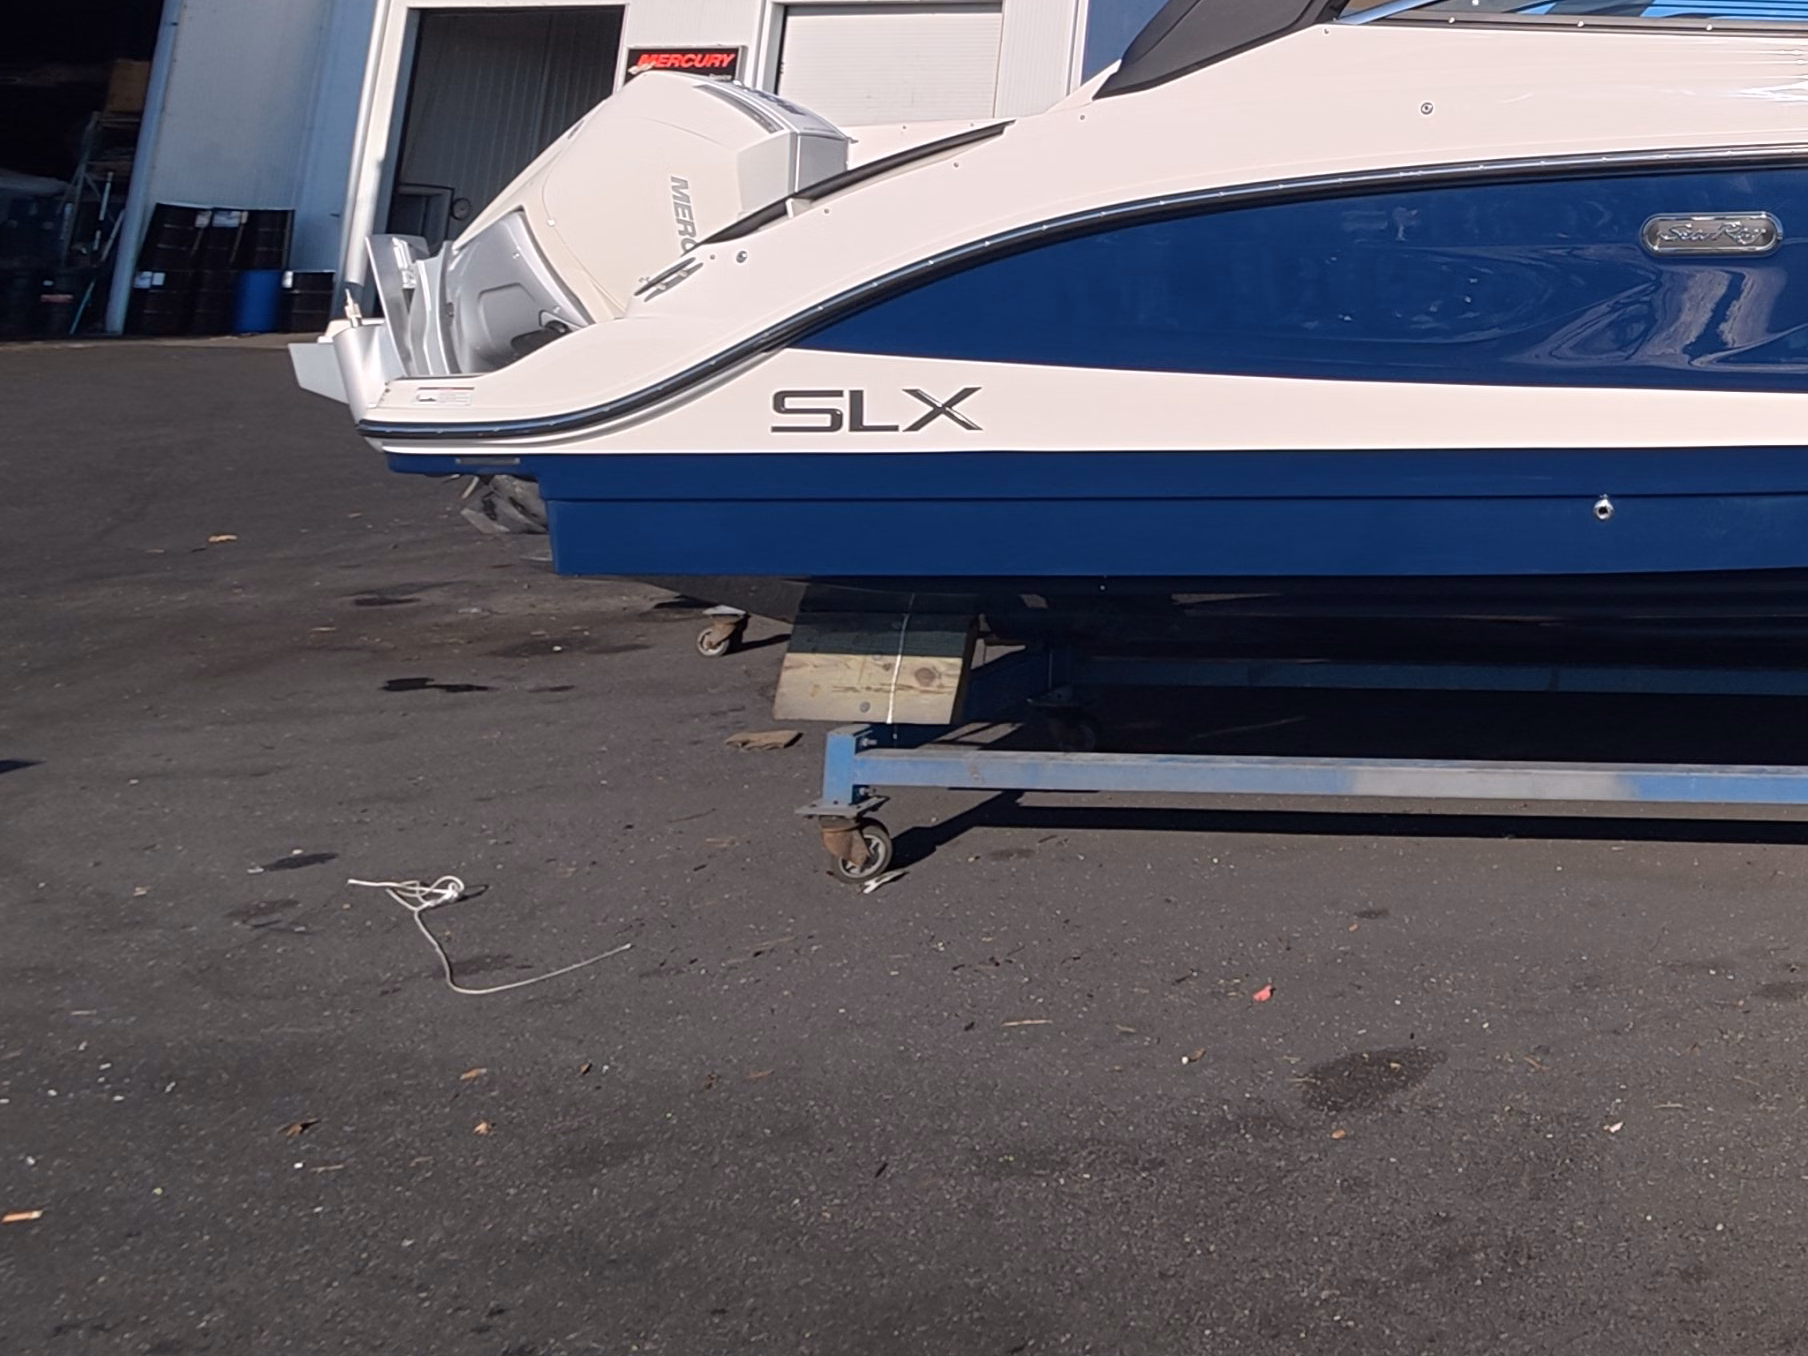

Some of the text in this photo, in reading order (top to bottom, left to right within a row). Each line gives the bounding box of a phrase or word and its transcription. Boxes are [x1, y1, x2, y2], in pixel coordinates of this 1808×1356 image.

[637, 53, 736, 68] MERCURY
[1656, 221, 1767, 245] Sea Ray
[771, 387, 983, 432] SLX
